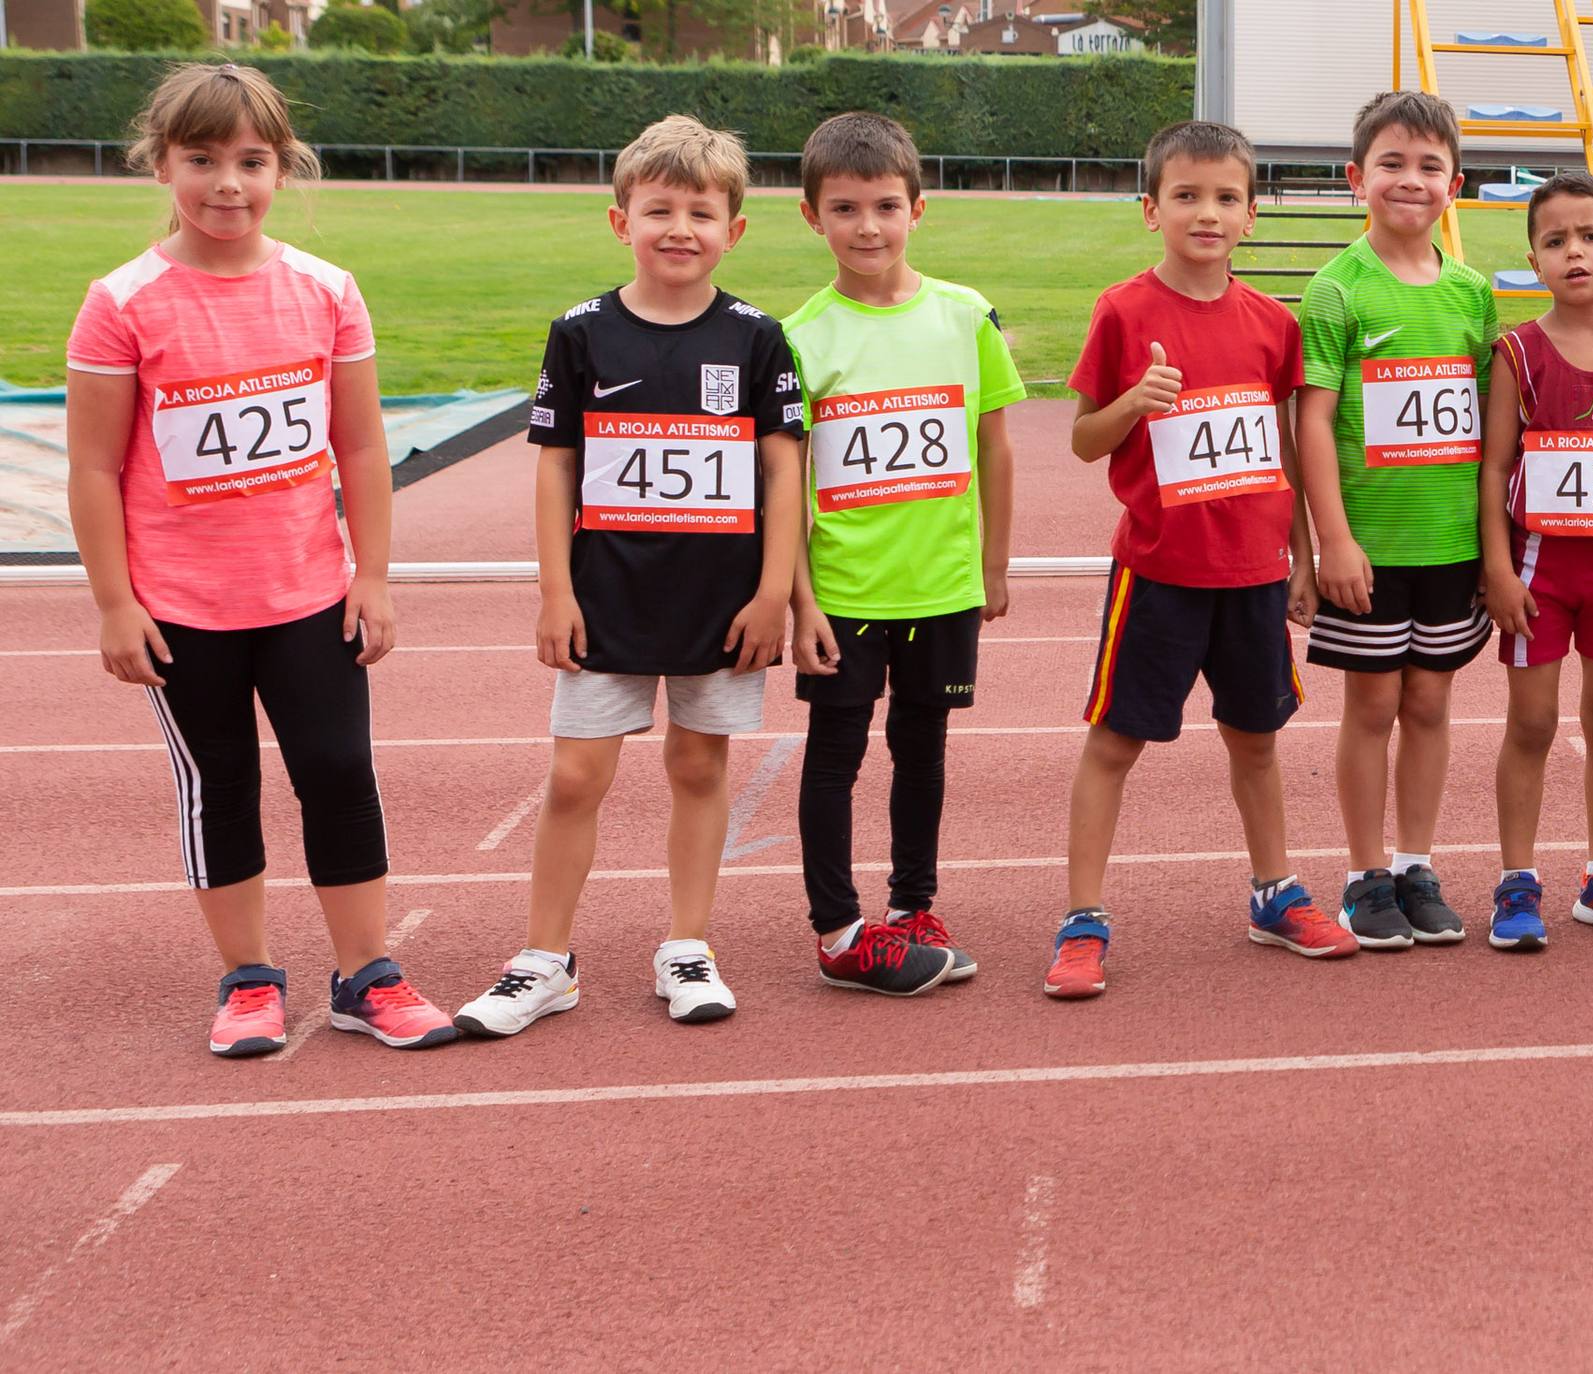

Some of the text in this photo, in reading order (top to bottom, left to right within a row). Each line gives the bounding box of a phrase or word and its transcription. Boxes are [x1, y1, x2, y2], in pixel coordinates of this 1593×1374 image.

[564, 298, 602, 321] NIKE
[728, 301, 766, 319] NIKE
[1377, 364, 1472, 379] LA RIOJA ATLETISMO
[163, 368, 313, 405] LA RIOJA ATLETISMO
[820, 393, 949, 418] LA RIOJA ATLETISMO
[1182, 395, 1221, 411] RIOJA
[1224, 391, 1270, 406] ATLETISMO
[1396, 387, 1473, 437] 463
[196, 397, 312, 466] 425
[599, 422, 740, 437] LA RIOJA ATLETISMO
[842, 418, 948, 474] 428
[1189, 415, 1272, 468] 441
[1540, 437, 1553, 448] LA
[186, 460, 319, 495] www.lariojaatletismo.com
[617, 448, 731, 500] 451
[832, 479, 957, 501] www.lariojaatletismo.com
[600, 512, 738, 524] www.lariojaatletismo.com
[945, 684, 975, 694] KIPST
